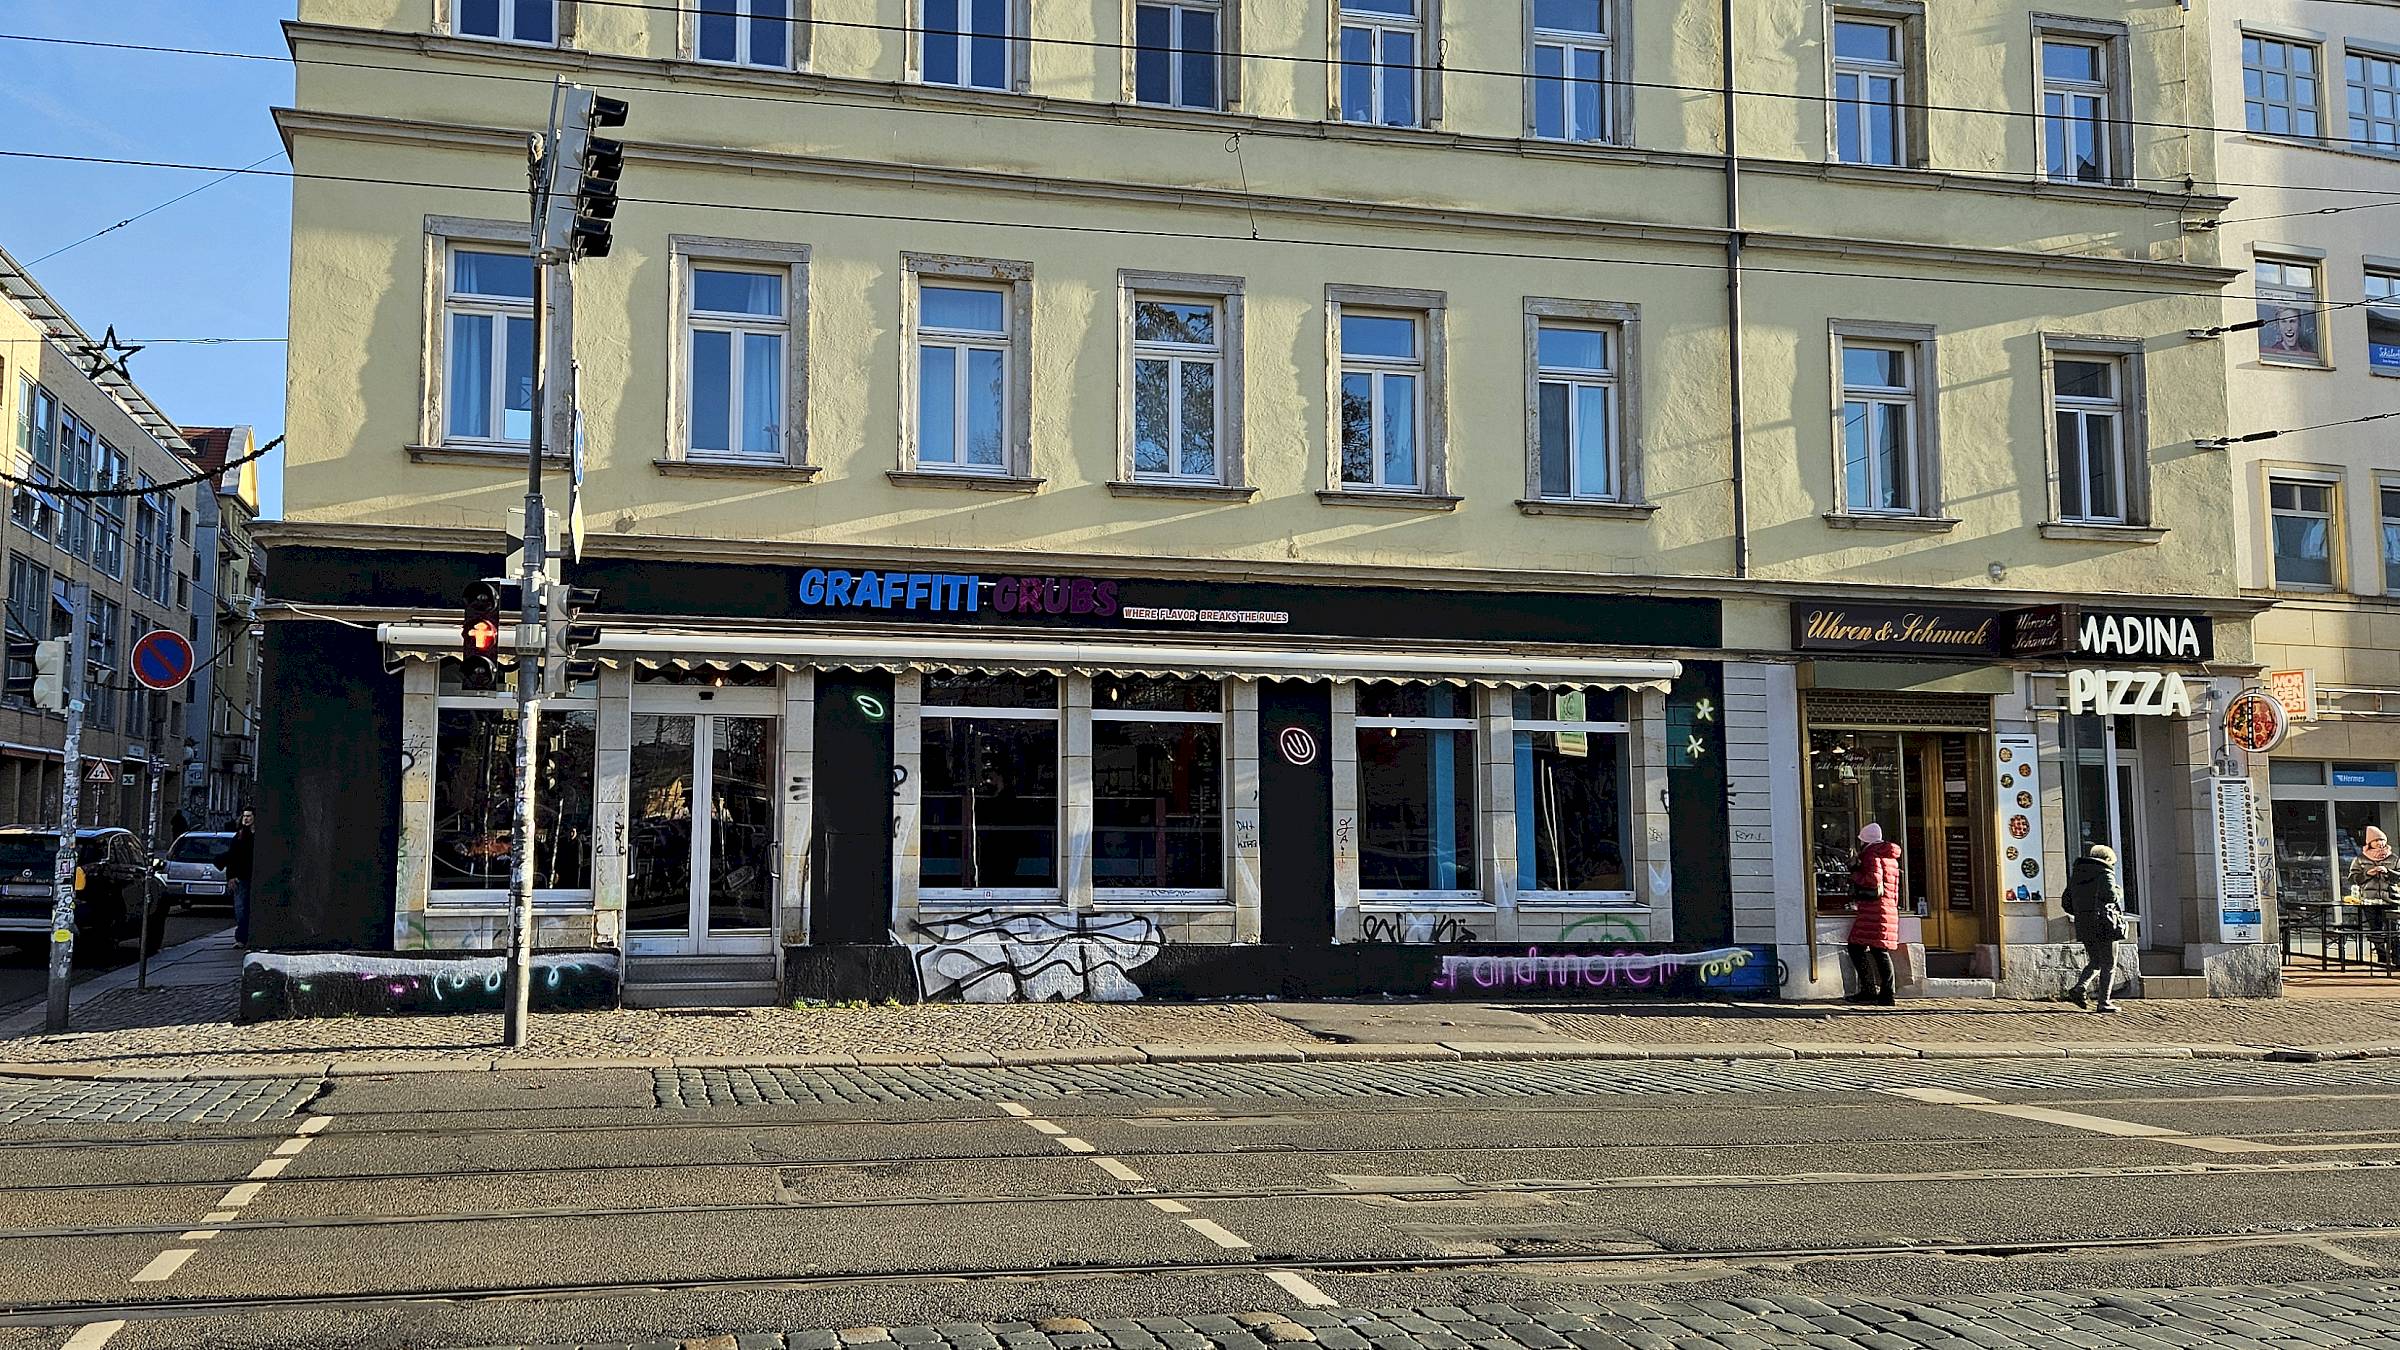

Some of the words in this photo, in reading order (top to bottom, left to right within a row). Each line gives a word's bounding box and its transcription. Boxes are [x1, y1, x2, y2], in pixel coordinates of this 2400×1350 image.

[800, 568, 979, 612] GRAFFITI
[992, 576, 1118, 616] GRUBS
[1123, 607, 1158, 619] WHERE
[1158, 608, 1198, 621] FLAVOR
[1199, 610, 1237, 622] BREAKS
[1238, 612, 1258, 622] THE
[1258, 612, 1289, 623] RULES
[1808, 610, 1873, 641] Uhren
[1875, 621, 1894, 642] &
[1894, 613, 1992, 646] Schmuck
[2080, 615, 2201, 656] MADINA
[2273, 674, 2303, 688] MOR
[2068, 668, 2192, 717] PIZZA
[2273, 686, 2303, 700] GEN
[2281, 699, 2305, 711] OST
[2343, 774, 2365, 783] Hermes
